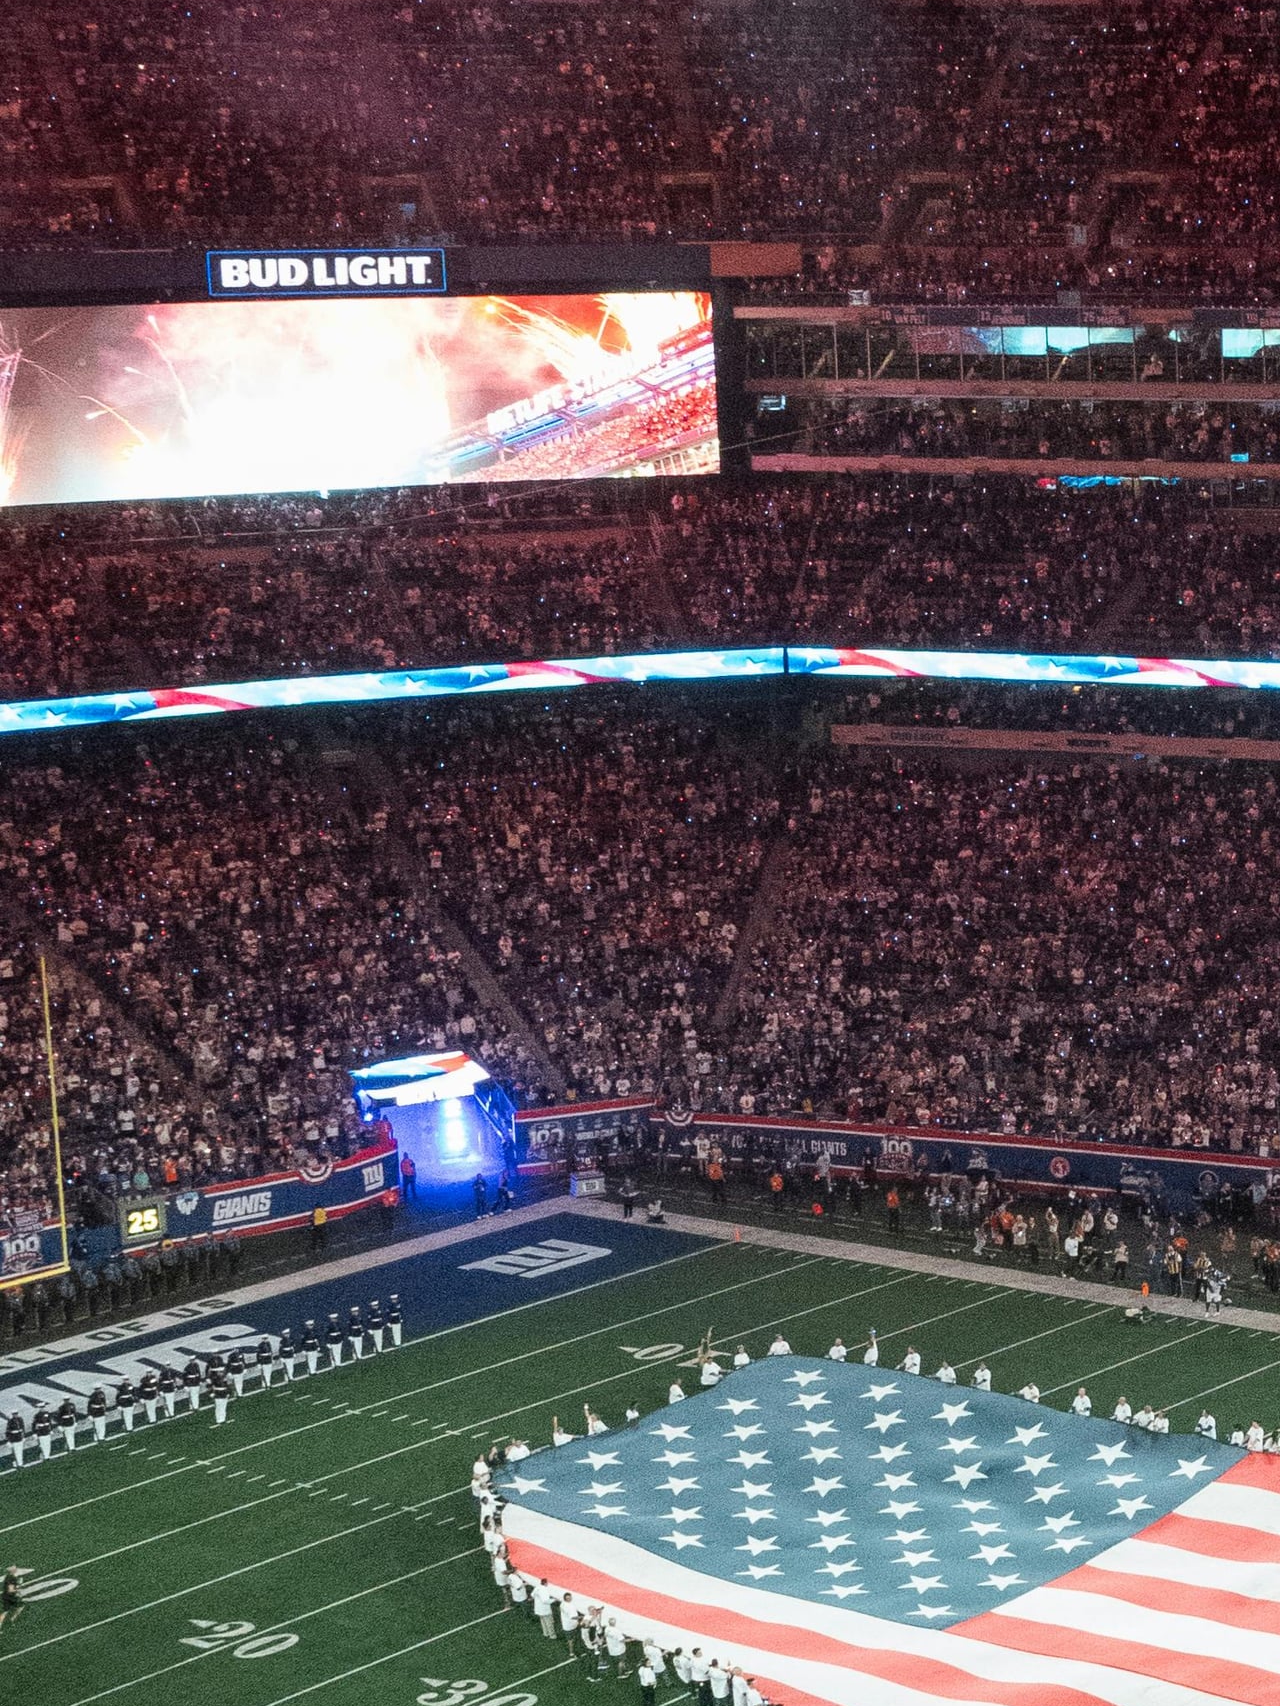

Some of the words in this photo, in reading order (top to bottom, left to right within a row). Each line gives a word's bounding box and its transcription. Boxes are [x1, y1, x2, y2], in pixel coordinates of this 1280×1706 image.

[220, 257, 308, 288] BUD
[313, 255, 431, 286] LIGHT
[128, 1209, 159, 1235] 25
[213, 1191, 272, 1222] GIANTS
[179, 1620, 299, 1659] 20
